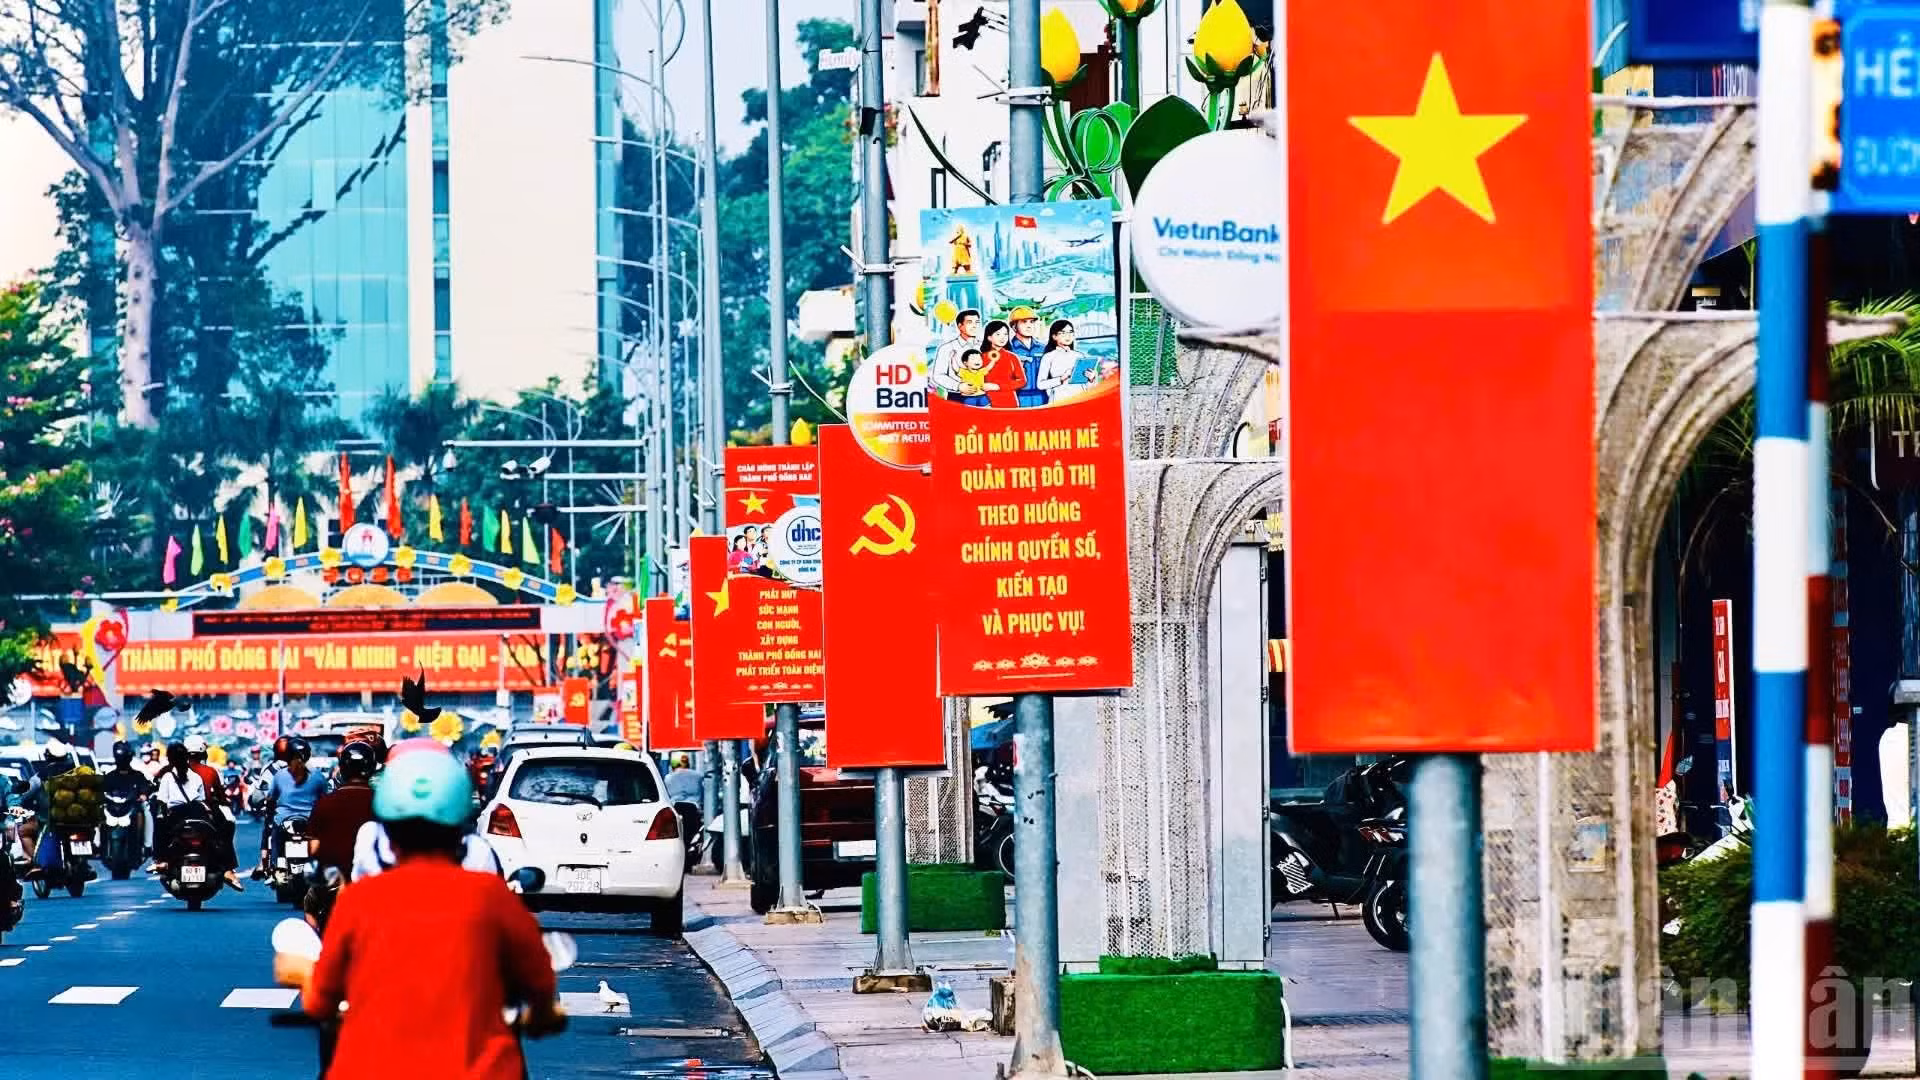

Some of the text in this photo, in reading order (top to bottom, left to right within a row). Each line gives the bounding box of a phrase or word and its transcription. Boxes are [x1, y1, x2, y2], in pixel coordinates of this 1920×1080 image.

[876, 364, 912, 385] HD
[955, 423, 1099, 455] ĐỔI MỚI MẠNH MẼ
[961, 460, 1095, 493] QUẢN TRỊ ĐÔ THỊ
[978, 496, 1081, 526] THEO HƯỚNG
[792, 520, 821, 542] dhc
[961, 530, 1101, 563] CHÍNH QUYỀN SỐ,
[759, 588, 797, 600] PHÁT HUY
[997, 570, 1067, 600] KIẾN TẠO
[759, 604, 798, 617] SỨC MẠNH
[757, 621, 773, 630] CON
[982, 608, 1085, 637] VÀ PHỤC VỤ!
[760, 634, 798, 647] XÂY DỰNG
[120, 643, 176, 672] THÀNH
[181, 639, 216, 672] PHỐ
[220, 639, 267, 671] ĐỒNG
[351, 645, 397, 670] MINH
[413, 640, 453, 672] HIỆN
[457, 644, 486, 673] ĐẠI
[739, 648, 821, 661] THÀNH PHỐ ĐỒNG NAI
[736, 665, 756, 677] PHÁT
[758, 663, 780, 676] TRIỂN
[782, 664, 801, 676] TOÀN
